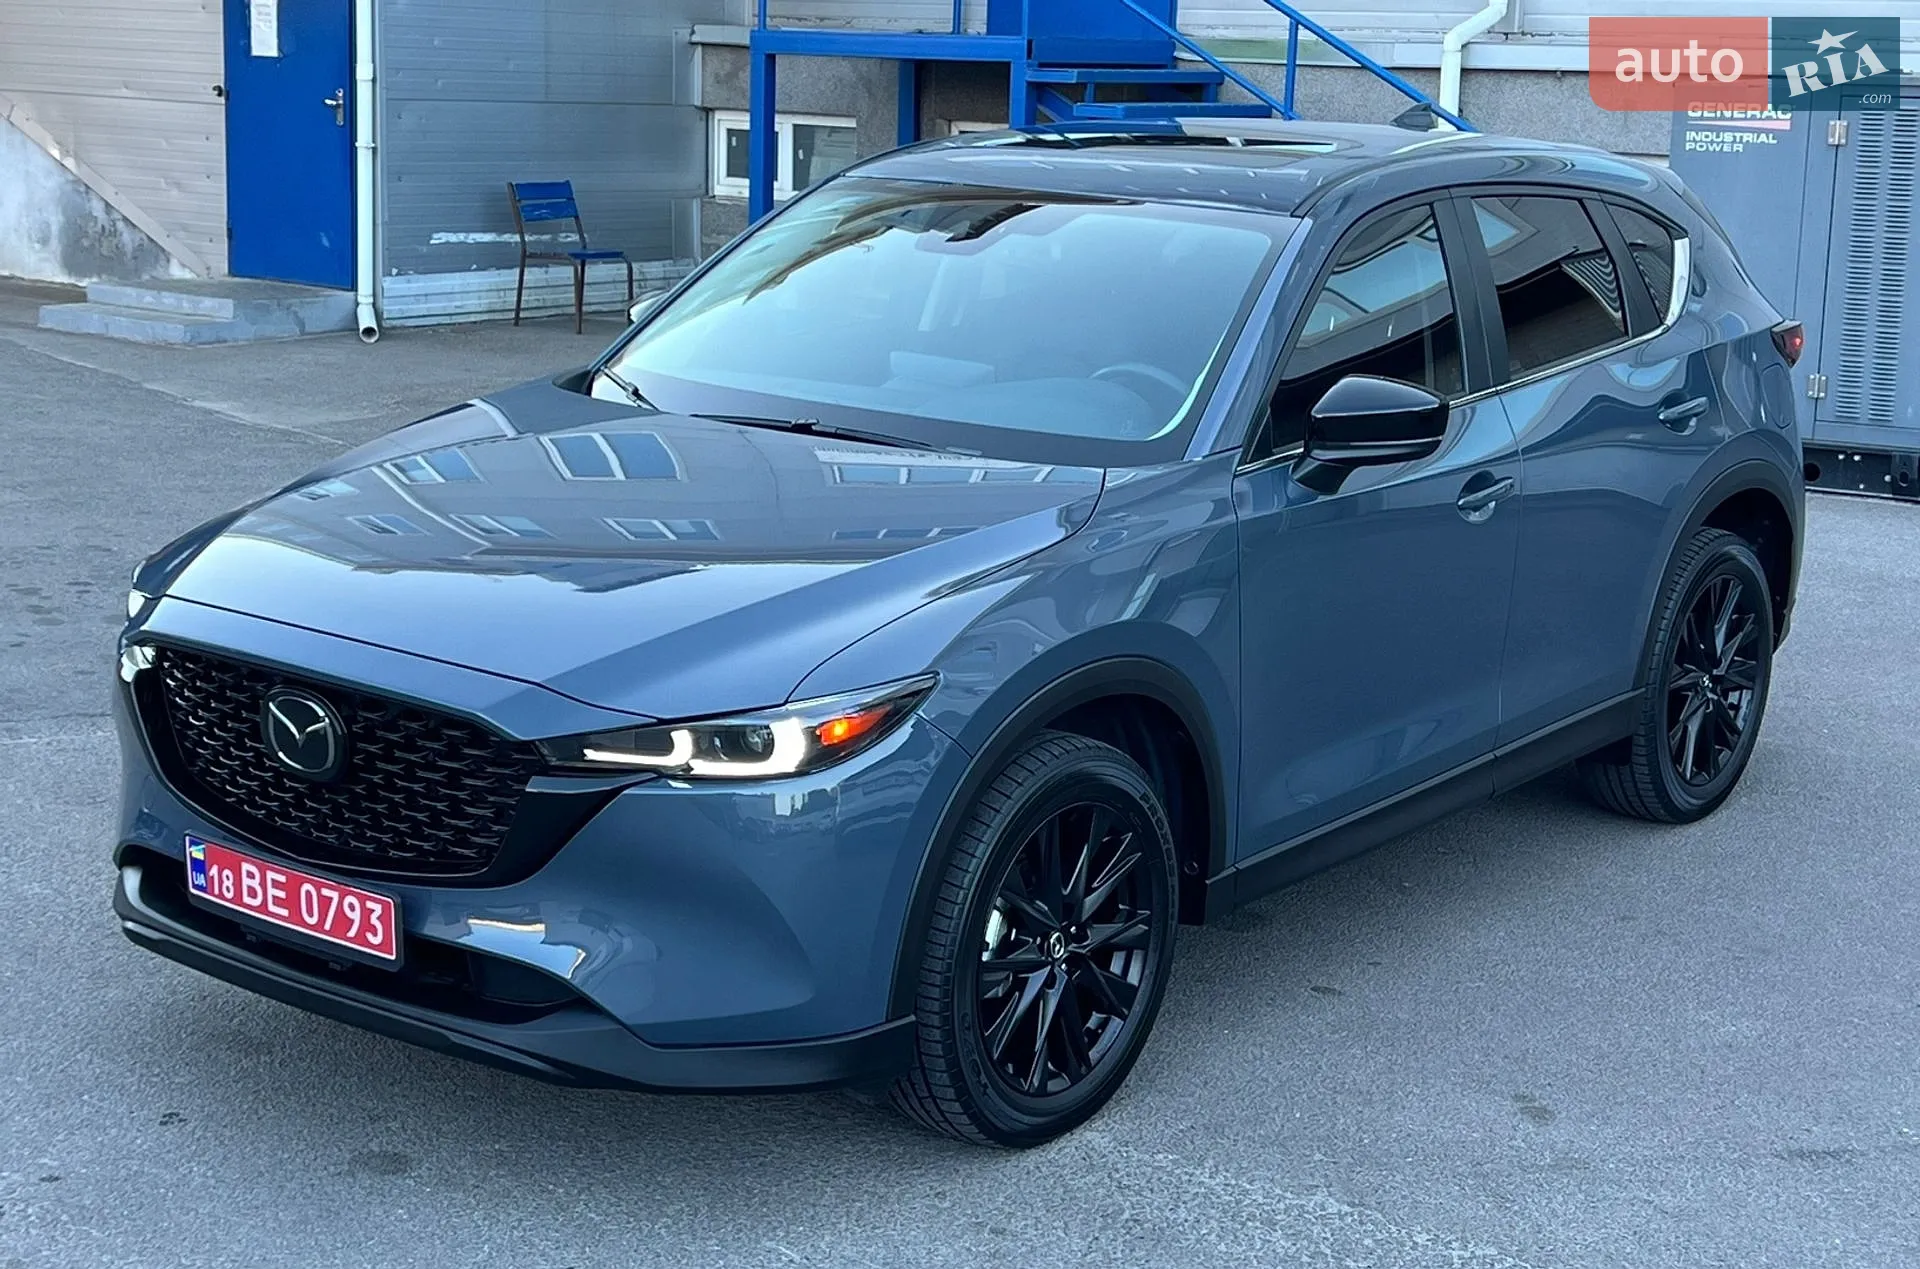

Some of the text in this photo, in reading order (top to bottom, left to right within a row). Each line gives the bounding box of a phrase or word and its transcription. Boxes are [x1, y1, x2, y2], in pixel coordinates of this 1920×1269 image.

[1687, 101, 1793, 119] GENERAC
[1685, 130, 1778, 144] INDUSTRIAL
[1685, 142, 1744, 153] POWER
[192, 871, 207, 888] UA
[209, 861, 384, 945] 18 BE 0793
